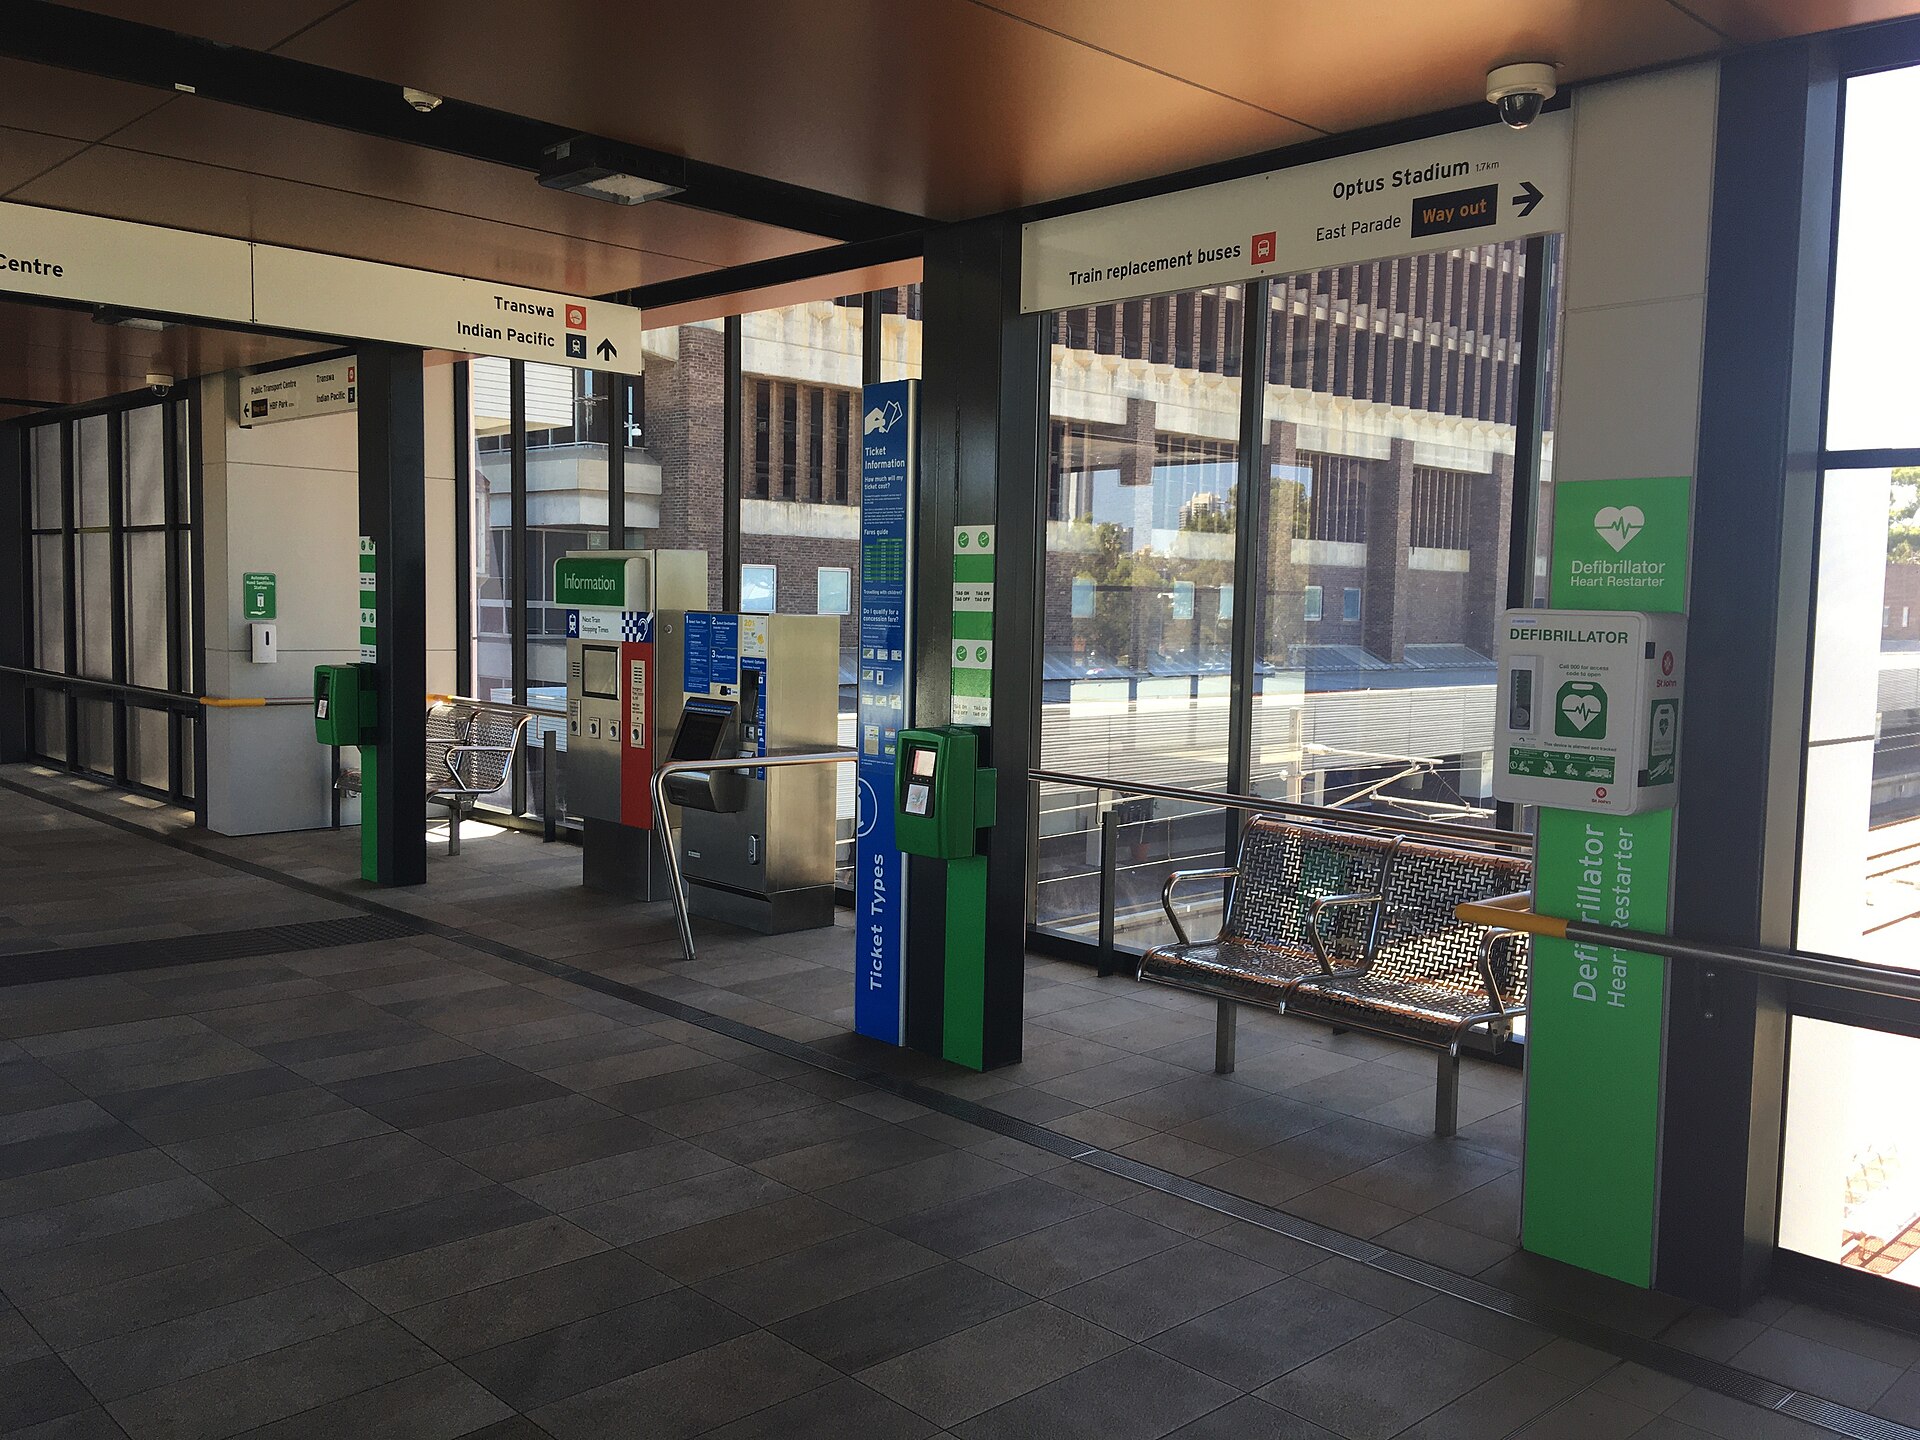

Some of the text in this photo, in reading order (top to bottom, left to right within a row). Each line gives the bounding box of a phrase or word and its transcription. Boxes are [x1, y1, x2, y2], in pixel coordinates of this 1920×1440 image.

[1332, 160, 1500, 200] Optus Stadium 1.7km
[1422, 198, 1487, 224] Way out
[1316, 214, 1401, 241] East Parade
[0, 253, 63, 277] Centre
[1069, 245, 1241, 286] Train replacement buses
[494, 296, 554, 317] Transwa
[457, 321, 555, 347] Indian Pacific
[316, 374, 335, 383] Transwa
[251, 381, 297, 395] Public Transport Centre
[316, 391, 346, 403] Indian Pacific
[865, 446, 886, 456] Ticket
[865, 458, 905, 470] Information
[876, 528, 889, 536] guide
[1571, 560, 1666, 574] Defibrillator
[564, 572, 616, 591] Information
[1570, 575, 1665, 587] Heart Restarter
[873, 608, 888, 616] qualify
[712, 616, 716, 625] 2
[1509, 628, 1628, 644] DEFIBRILLATOR
[711, 650, 716, 658] 3
[1656, 679, 1677, 688] St John
[1572, 823, 1604, 1002] Defirillator
[869, 853, 886, 991] Ticket Types
